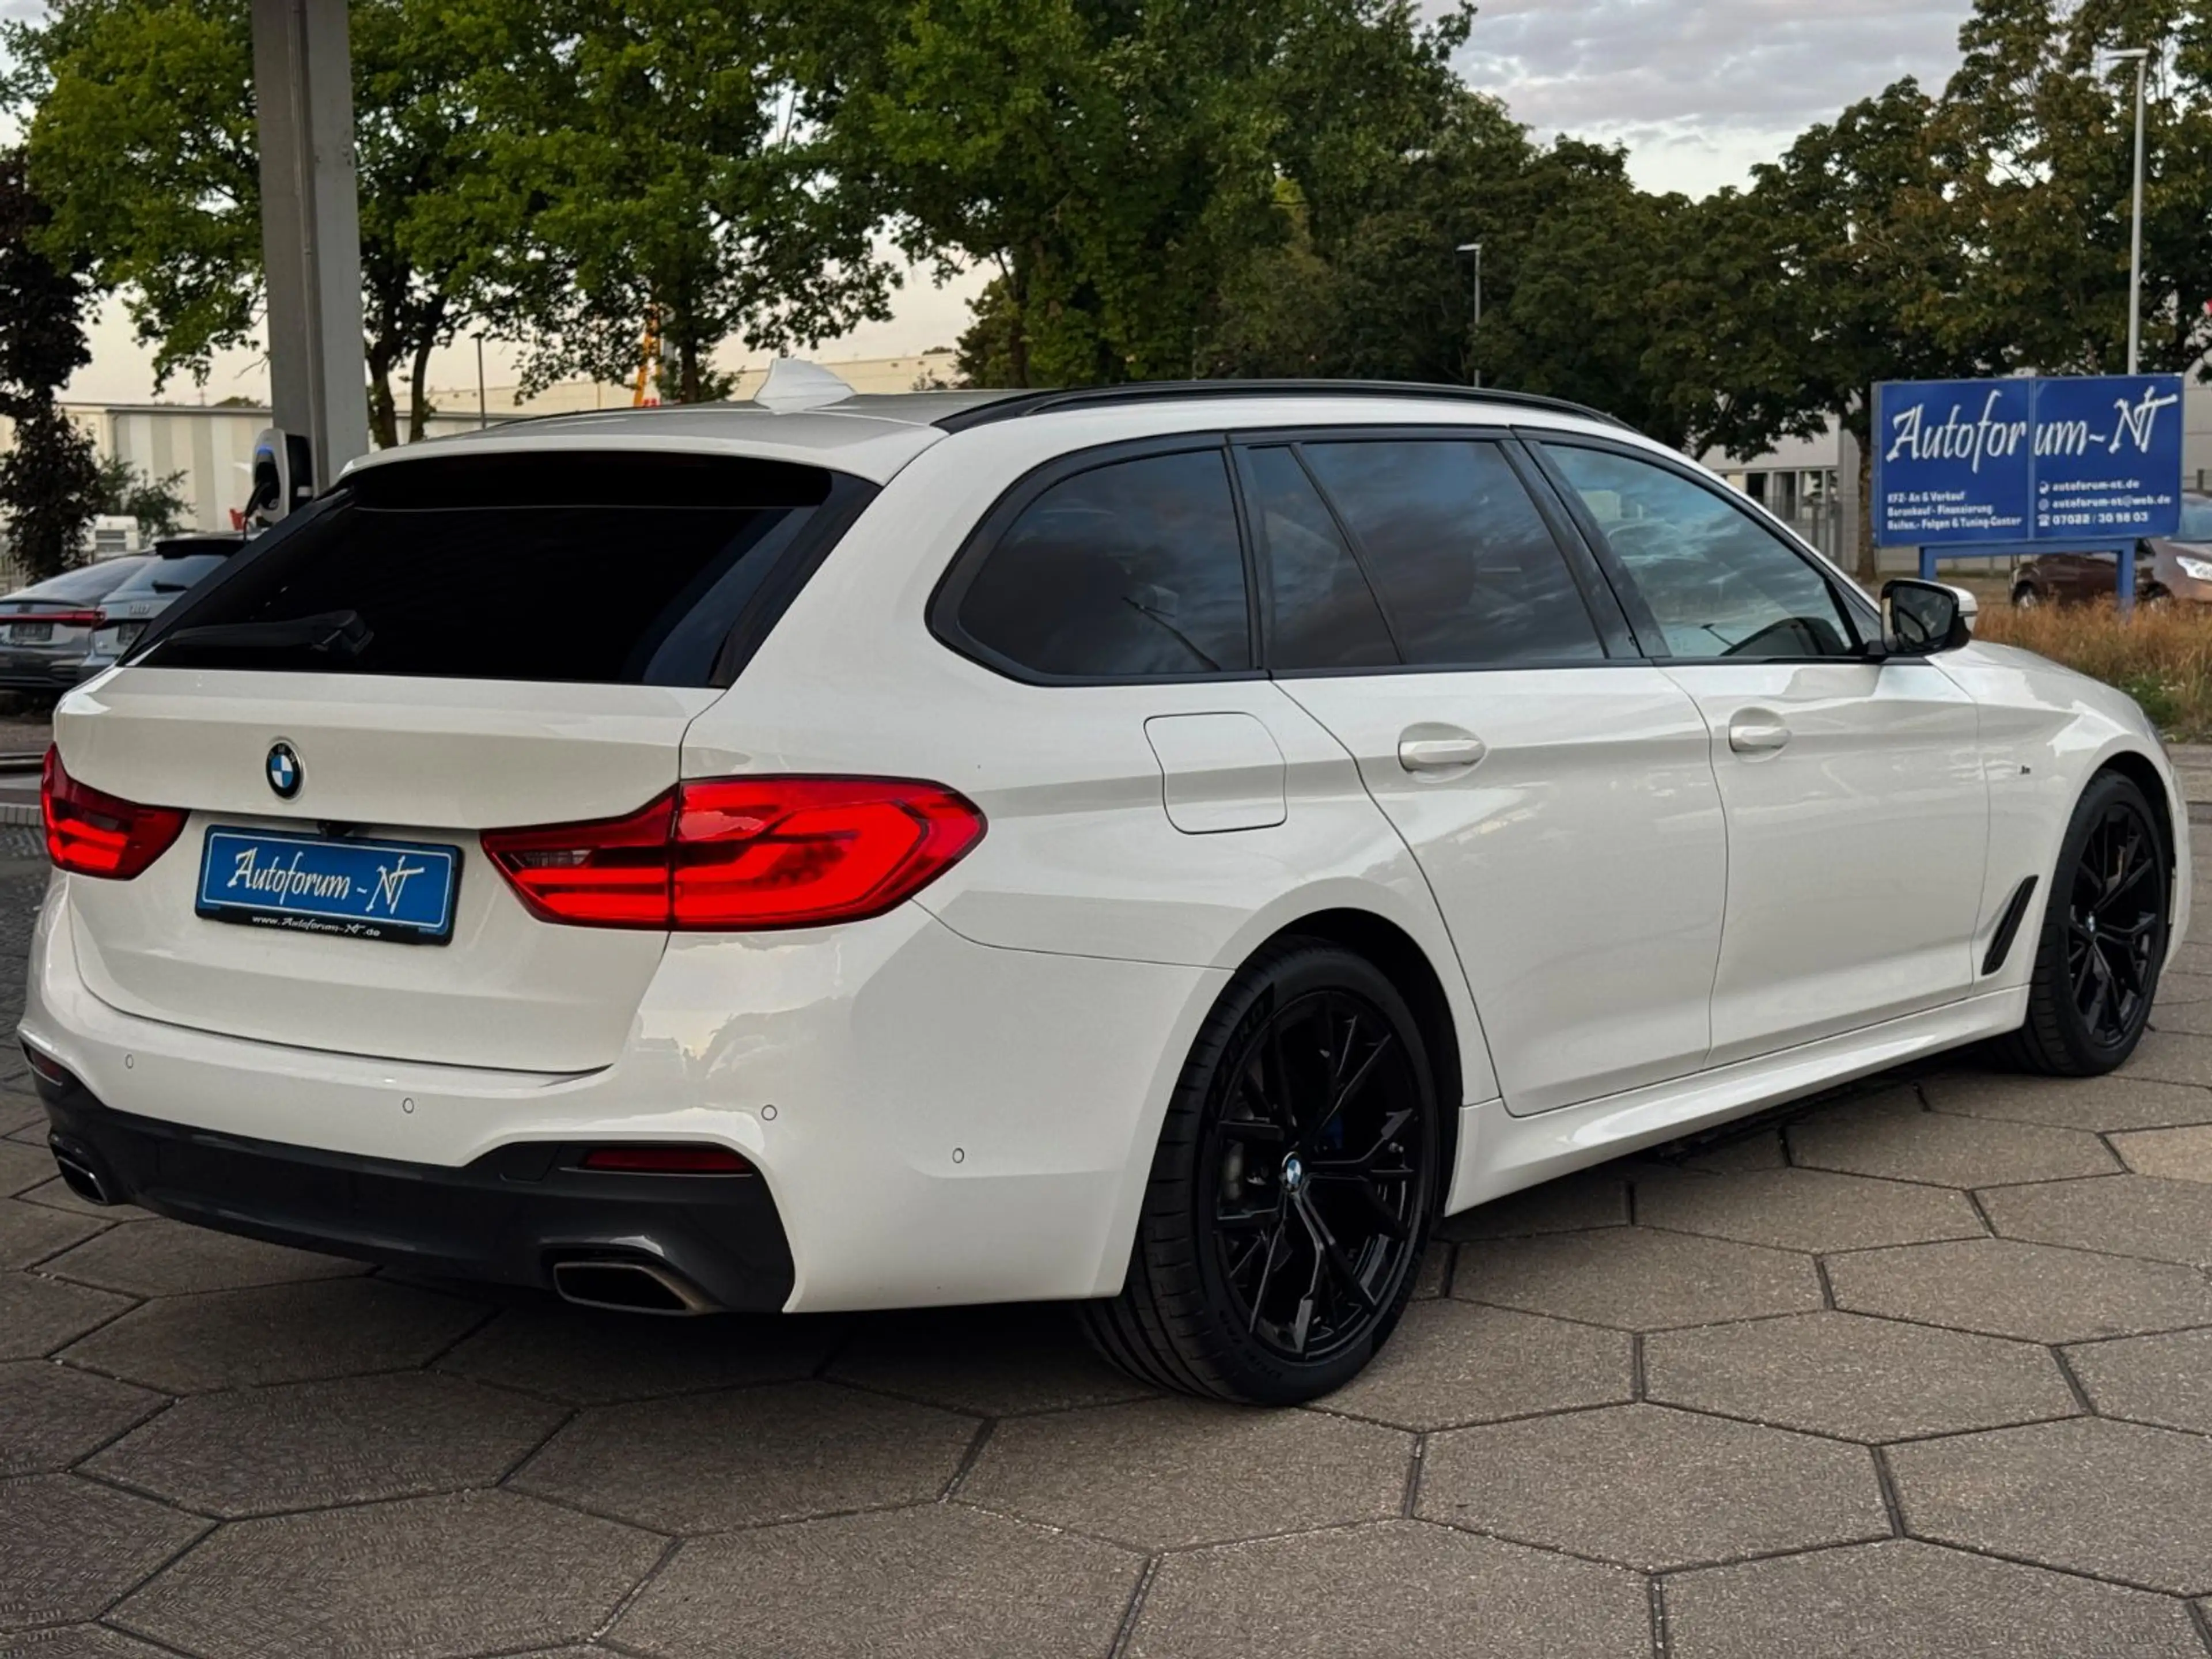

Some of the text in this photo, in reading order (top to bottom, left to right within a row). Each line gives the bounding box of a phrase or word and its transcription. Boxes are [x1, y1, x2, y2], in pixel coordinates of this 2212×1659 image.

[2052, 478, 2140, 491] autoforum-nt.de
[1930, 490, 1965, 502] Verkauf
[2052, 494, 2171, 509] autoforum-nt@web.de
[1937, 504, 1994, 516] Finanzierung
[1960, 516, 2022, 529] Tuning-Center
